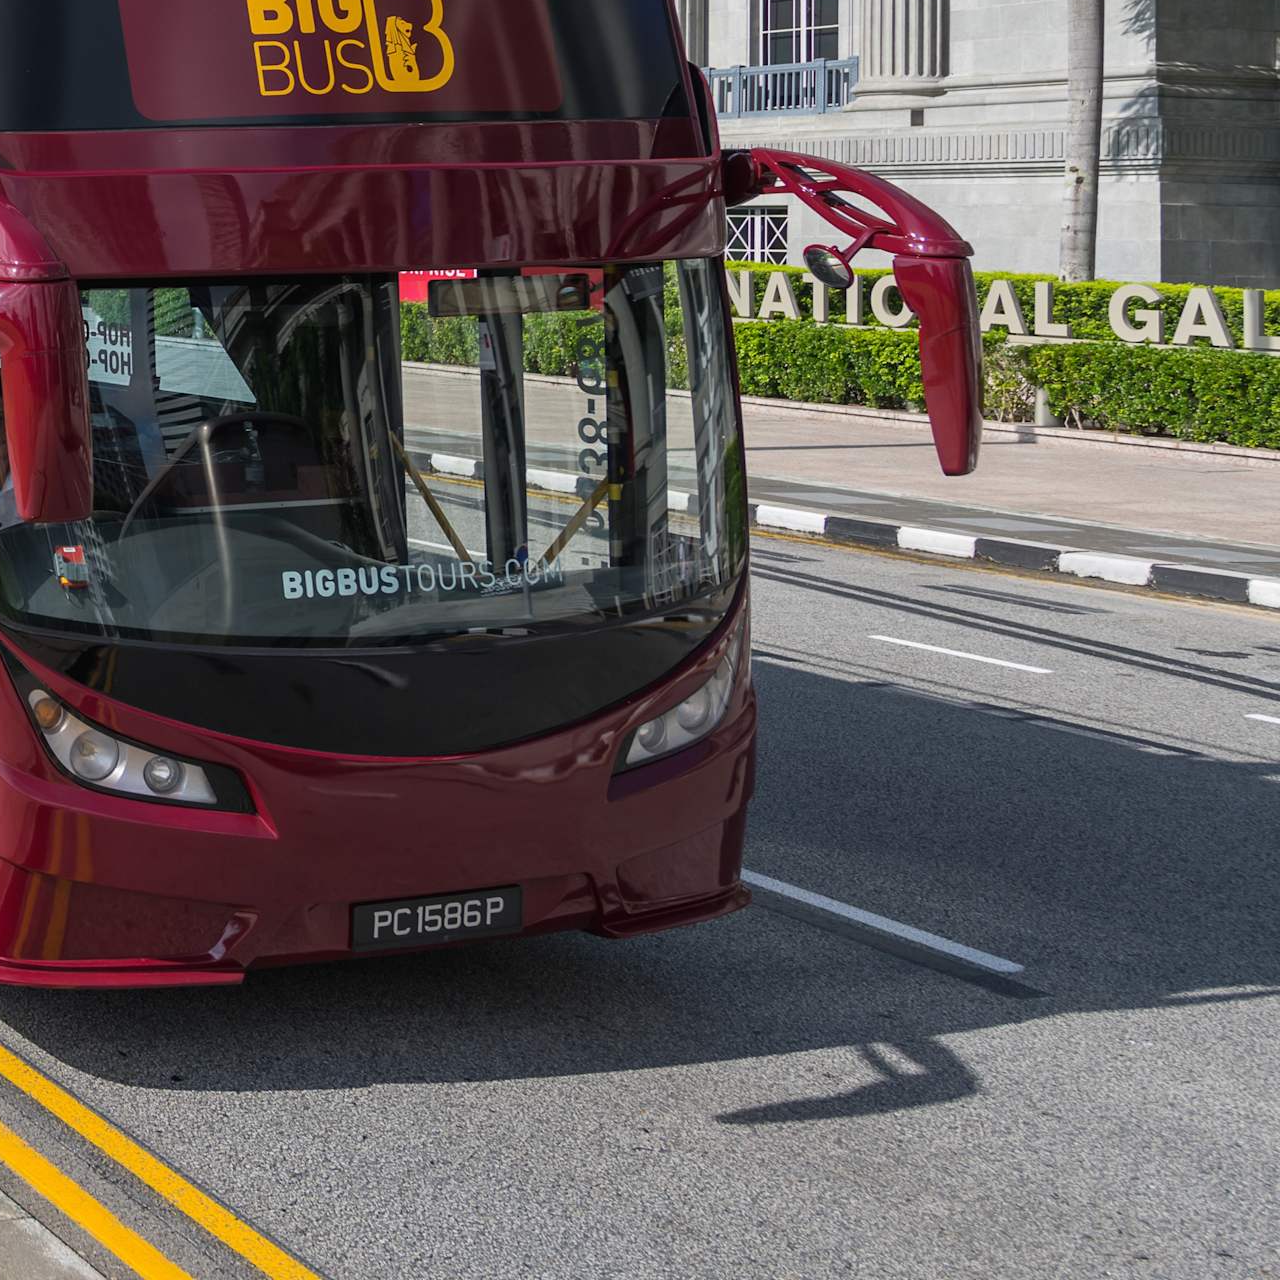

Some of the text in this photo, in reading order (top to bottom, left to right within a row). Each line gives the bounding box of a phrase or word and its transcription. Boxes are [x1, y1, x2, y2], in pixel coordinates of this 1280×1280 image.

[253, 39, 374, 96] BUS
[726, 269, 1280, 354] NATIOAL GAL
[282, 557, 563, 600] BIGBUSTOURS.COM
[373, 896, 504, 939] PC1586P
